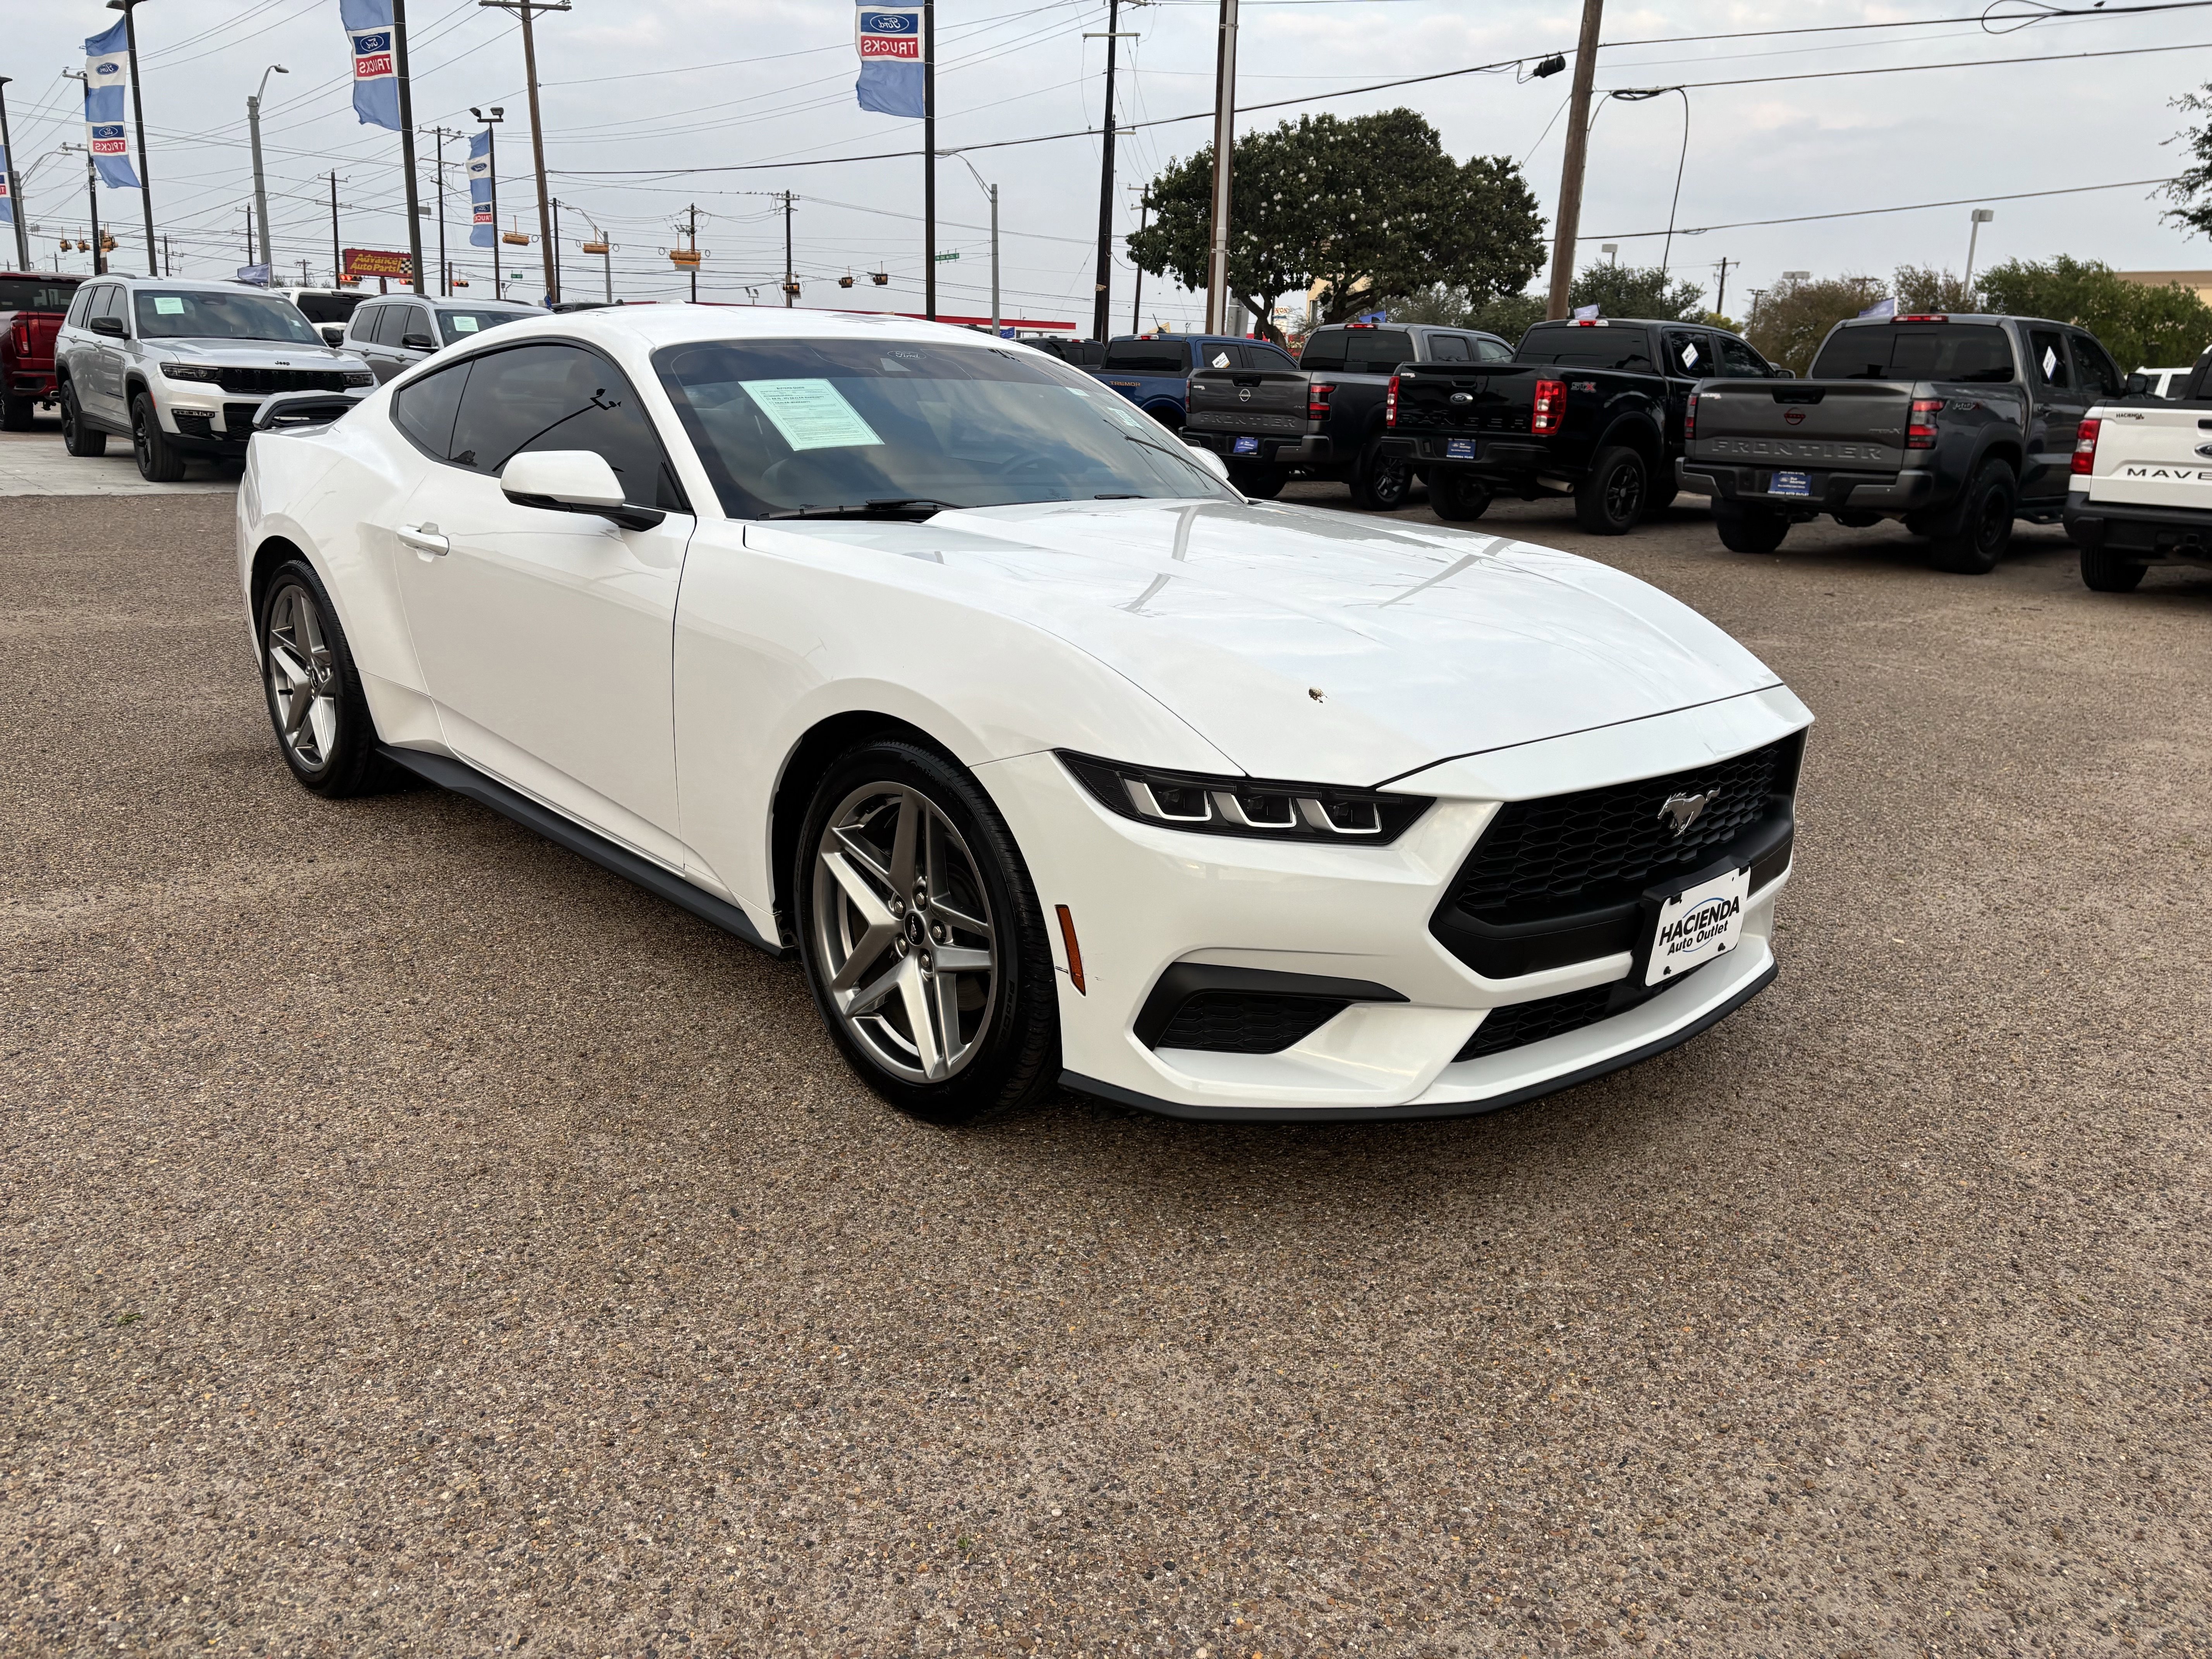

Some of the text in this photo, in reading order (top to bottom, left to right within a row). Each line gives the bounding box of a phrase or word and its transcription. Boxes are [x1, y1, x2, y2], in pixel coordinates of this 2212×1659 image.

[355, 254, 398, 264] Advance
[350, 262, 397, 272] Auto Parts
[1571, 381, 1596, 393] STX
[1200, 413, 1295, 428] FRONTIER
[1712, 440, 1882, 460] FRONTIER
[1659, 896, 1740, 946] HACIENDA
[1667, 920, 1728, 956] Auto Outlet
